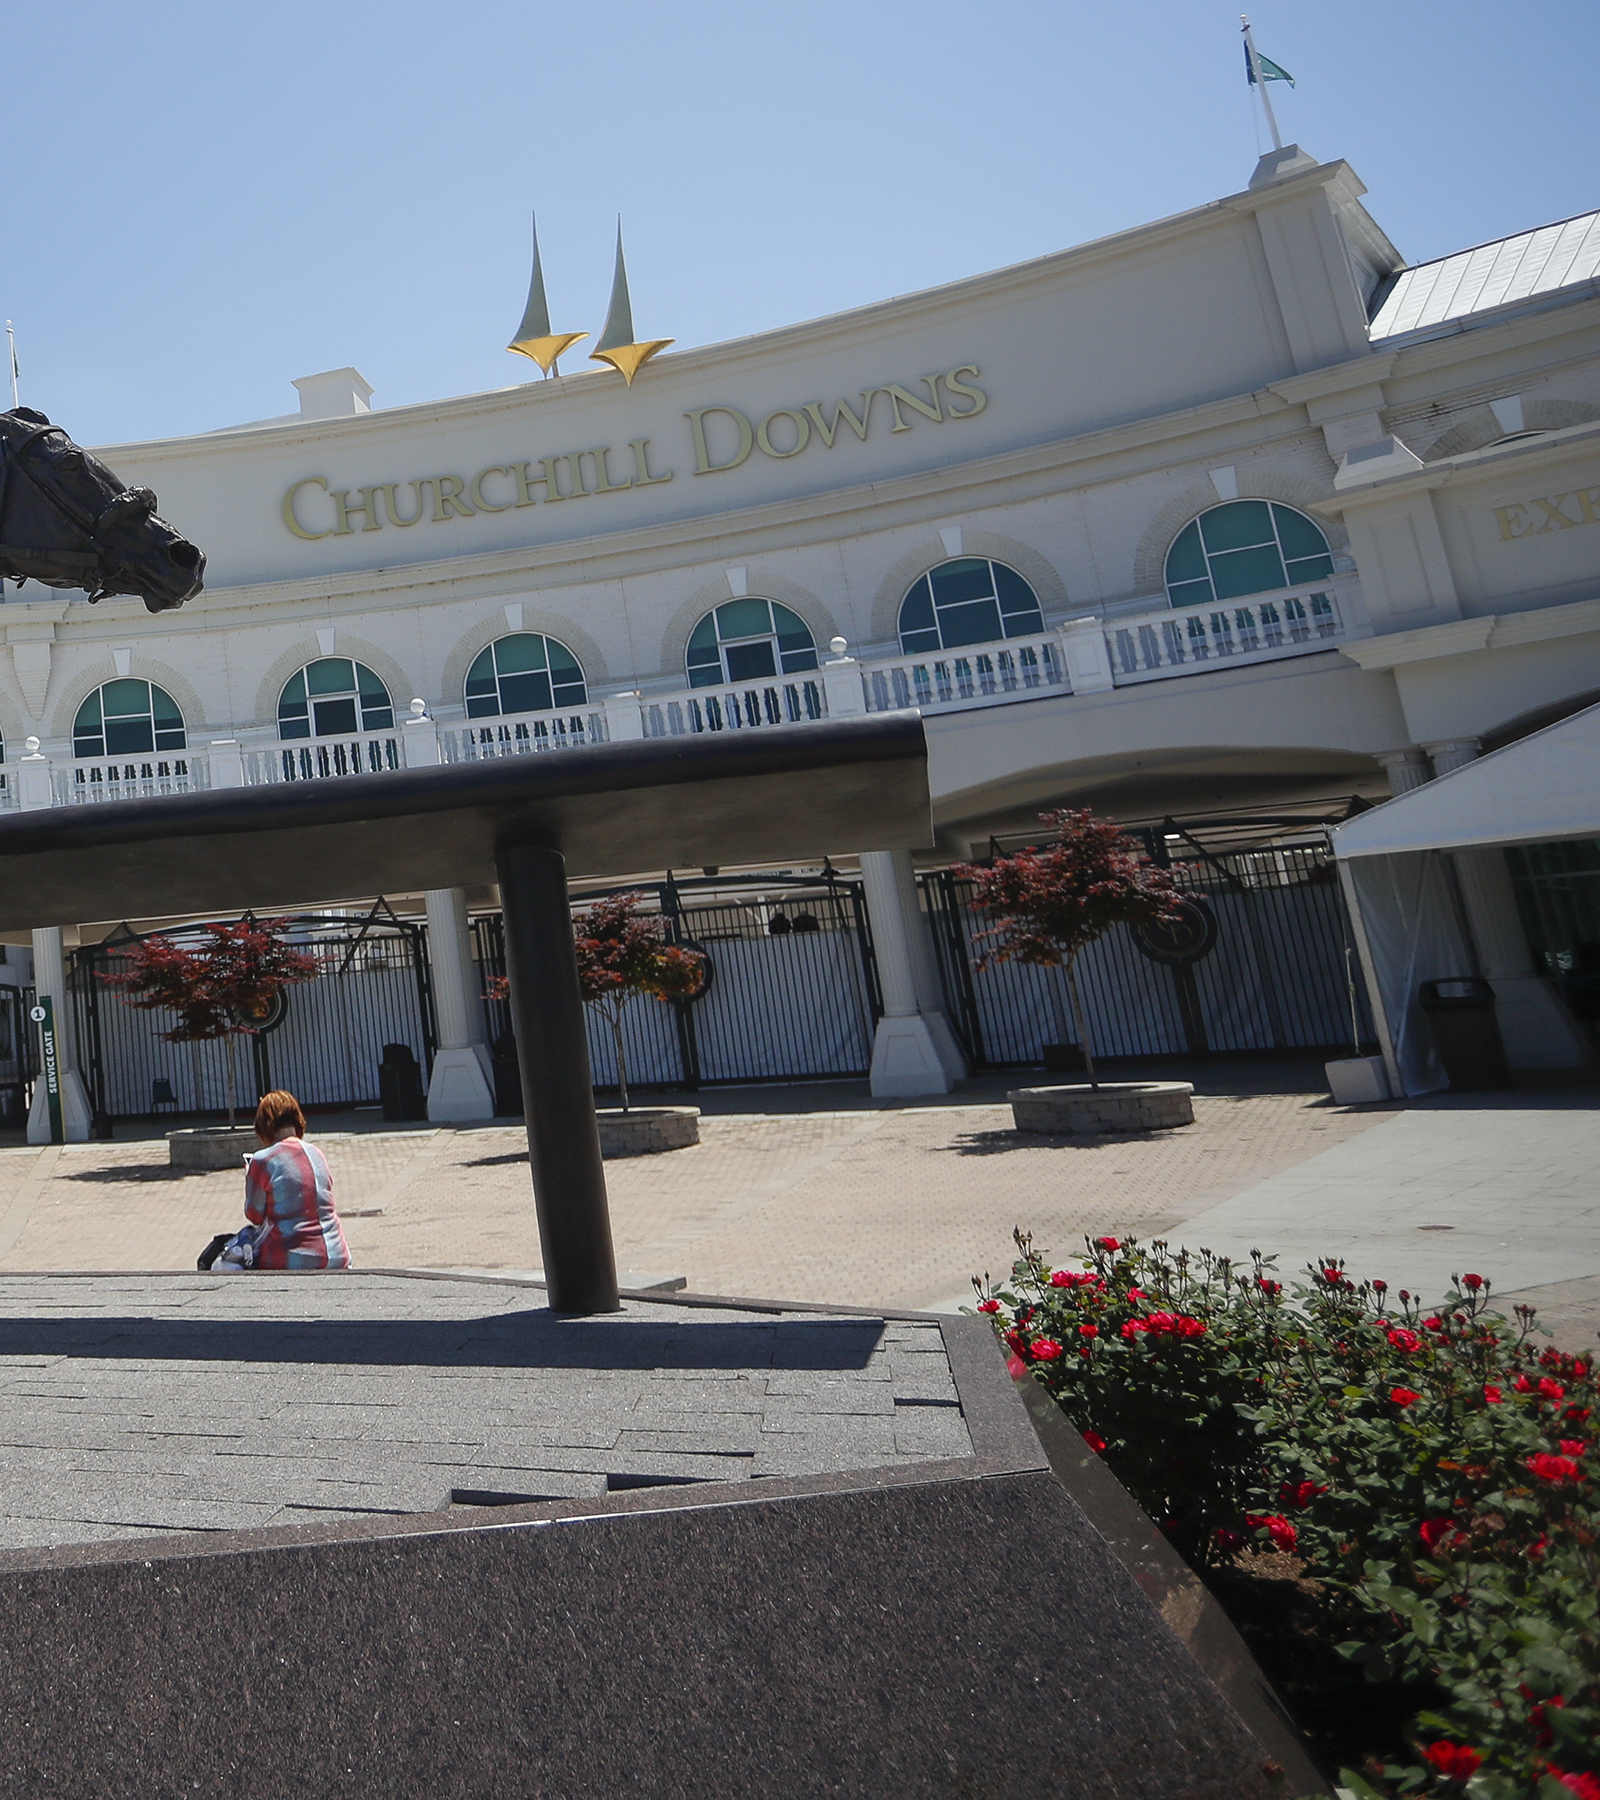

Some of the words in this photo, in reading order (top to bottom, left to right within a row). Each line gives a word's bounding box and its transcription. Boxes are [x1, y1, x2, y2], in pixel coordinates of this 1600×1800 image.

[282, 438, 674, 541] CHURCHILL
[684, 364, 990, 476] DOWNS
[43, 1030, 54, 1055] GATE
[46, 1055, 58, 1094] SERVICE
